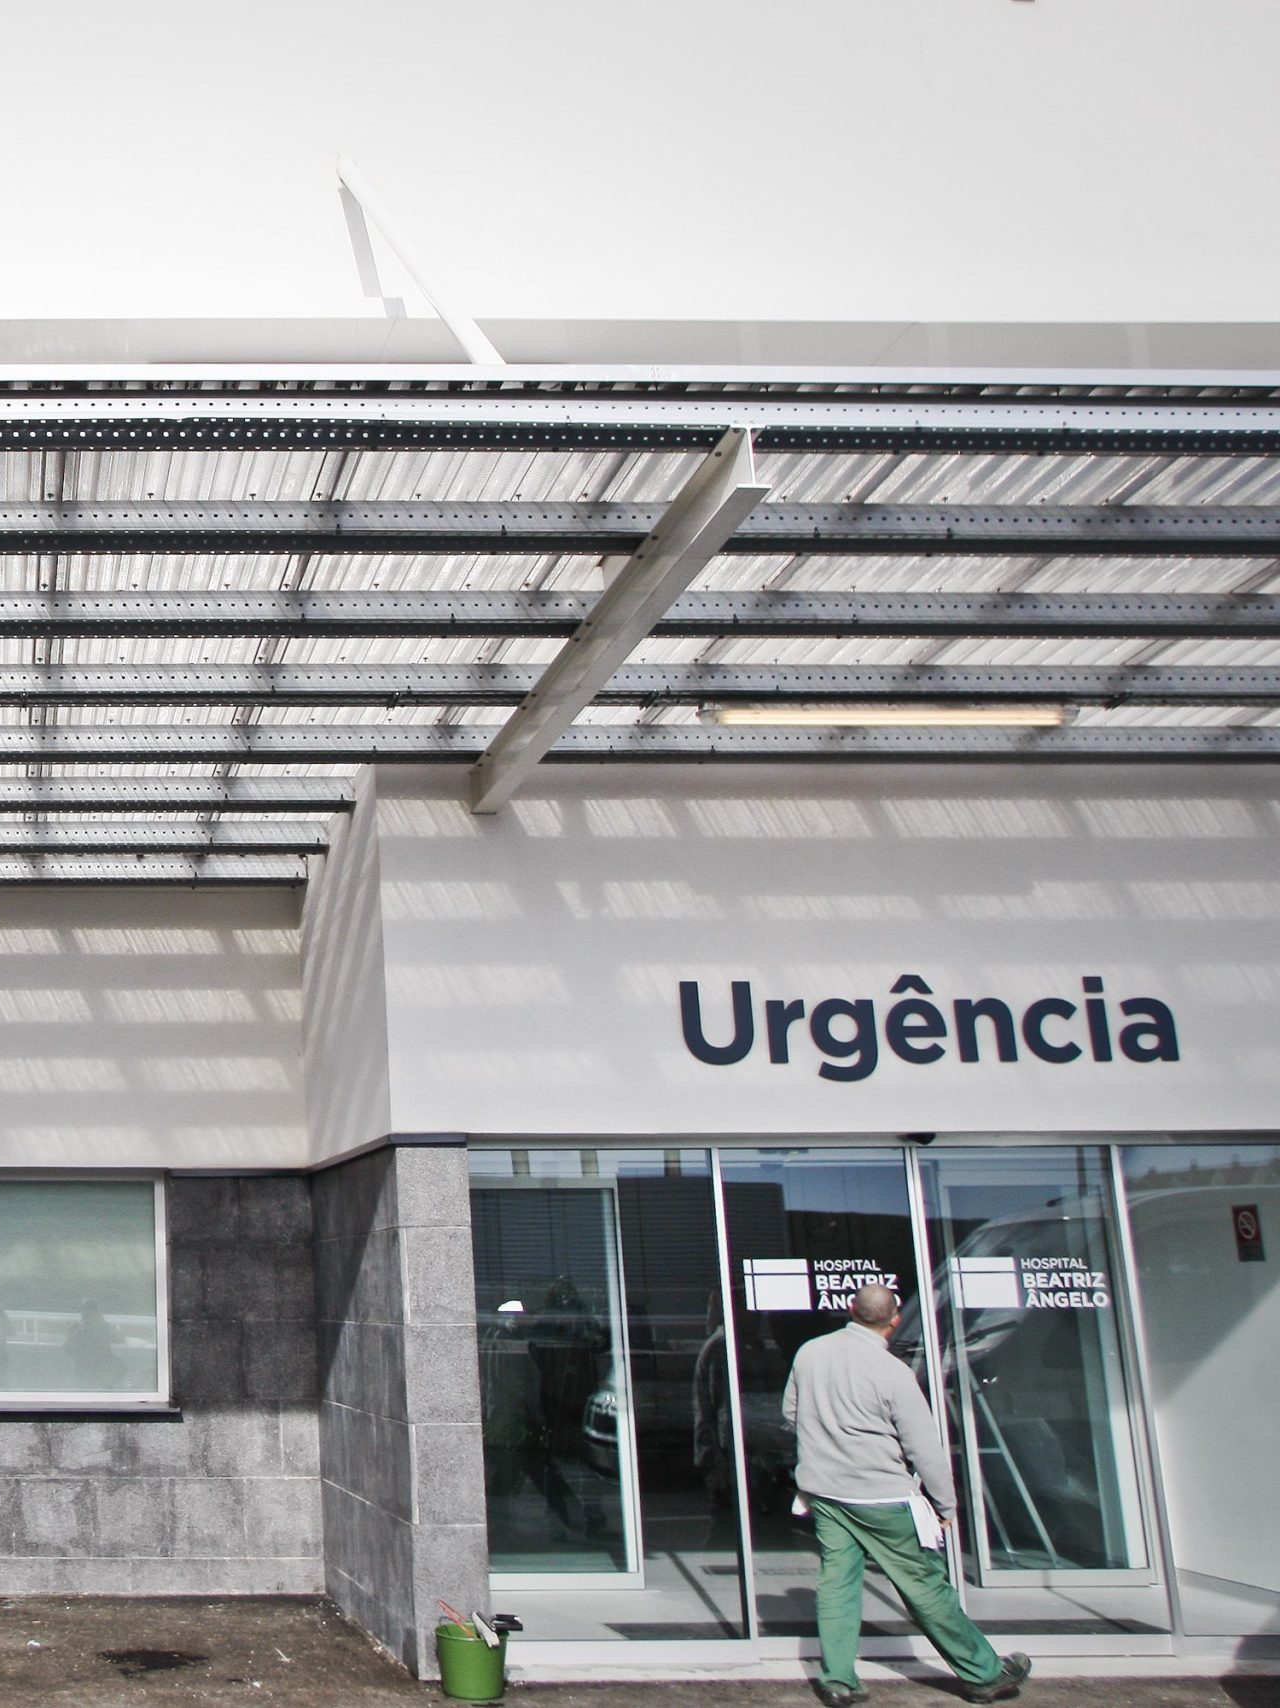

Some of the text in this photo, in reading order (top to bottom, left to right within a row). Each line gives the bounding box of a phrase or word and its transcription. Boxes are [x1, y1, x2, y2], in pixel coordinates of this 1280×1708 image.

[679, 974, 1180, 1083] Urgência
[813, 1259, 881, 1272] HOSPITAL
[1020, 1257, 1088, 1270] HOSPITAL
[815, 1273, 899, 1291] BEATRIZ
[1022, 1272, 1106, 1289] BEATRIZ
[1025, 1288, 1109, 1308] ÂNGELO
